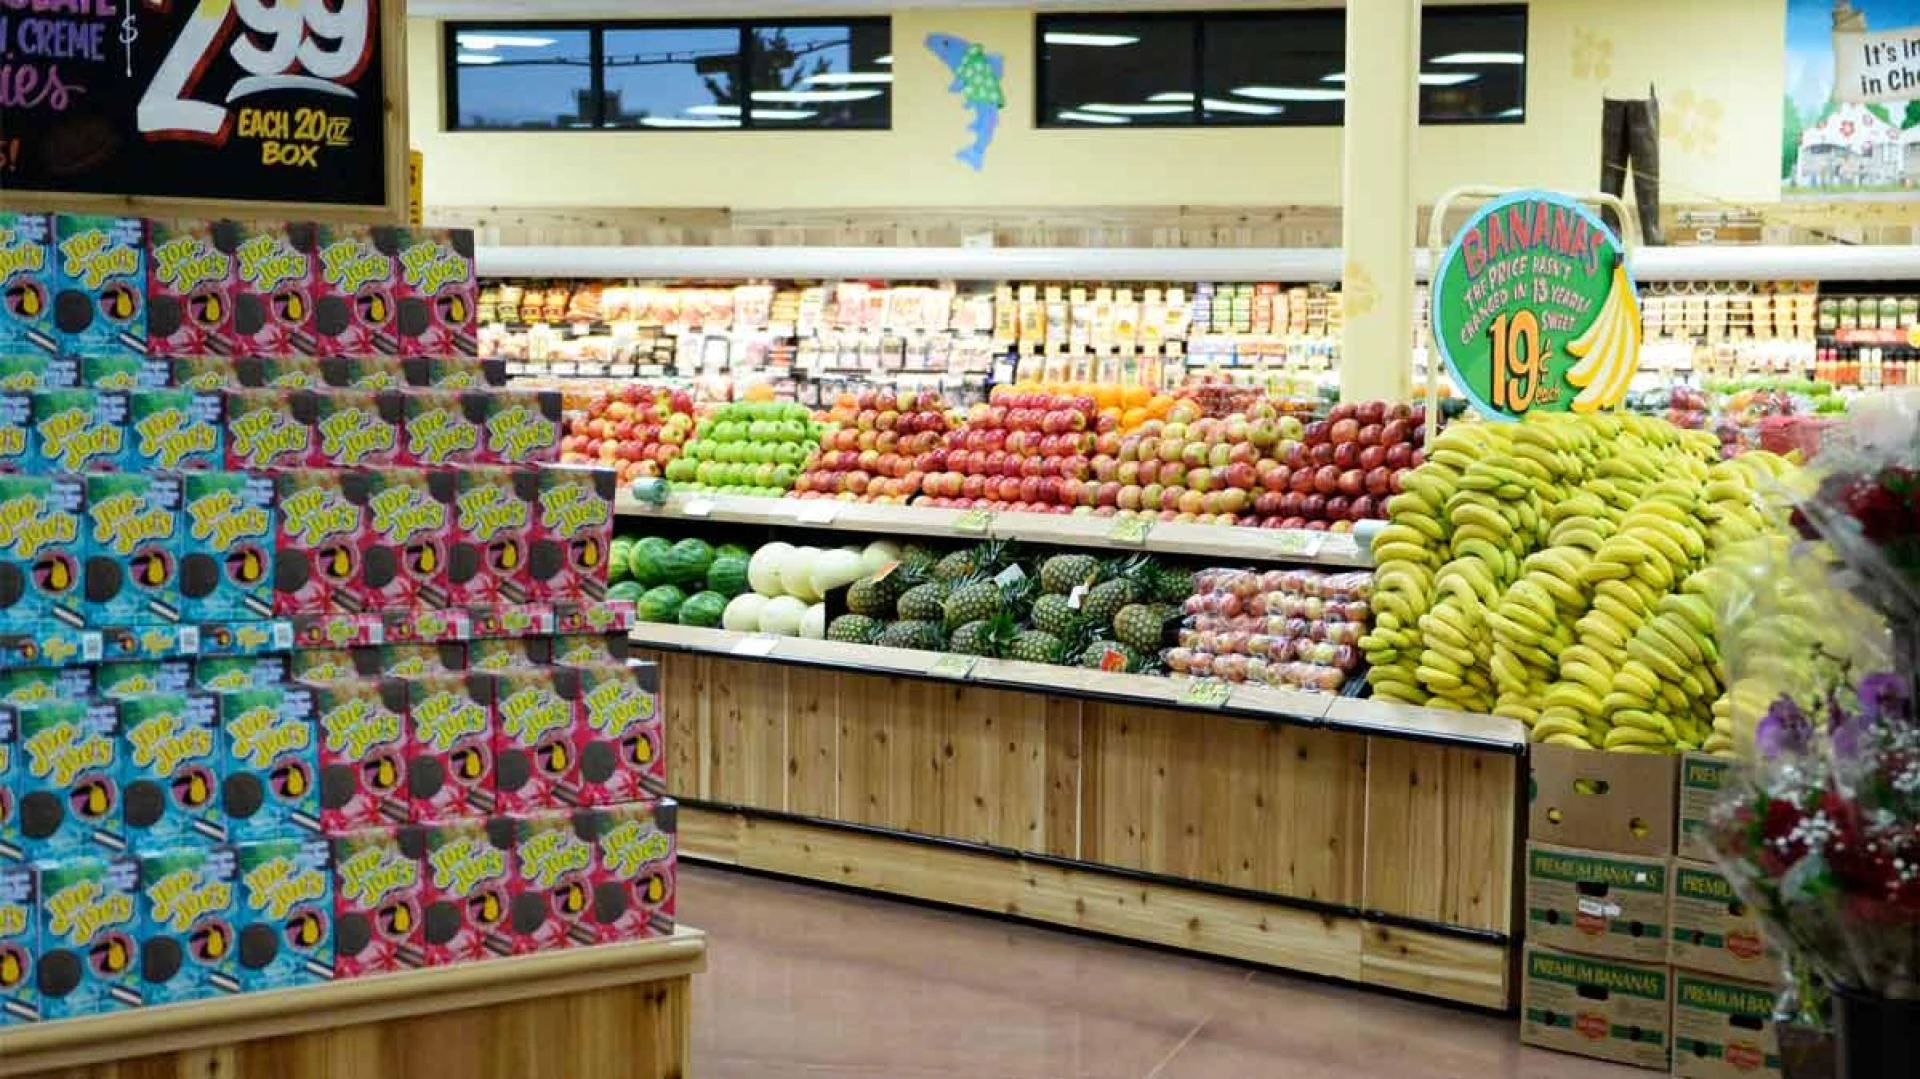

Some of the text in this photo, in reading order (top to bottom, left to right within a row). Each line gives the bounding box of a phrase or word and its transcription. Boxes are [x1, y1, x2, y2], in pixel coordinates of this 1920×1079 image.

[17, 18, 105, 61] CREME
[1864, 41, 1897, 67] It's
[1860, 75, 1882, 97] in
[237, 107, 290, 138] EACH
[294, 107, 327, 141] 20
[261, 140, 319, 168] BOX
[63, 231, 101, 275] Joe
[155, 239, 195, 282] Joe
[238, 234, 272, 280] Joe
[323, 239, 358, 282] Joe
[404, 242, 436, 283] Joe
[1462, 201, 1606, 281] BANANAS
[1464, 279, 1488, 311] THE
[1488, 255, 1528, 291] PRICE
[1514, 282, 1528, 302] IN
[40, 410, 84, 457] Joe
[138, 409, 180, 455] Joe
[233, 408, 272, 455] Joe
[322, 408, 359, 453] Joe
[409, 409, 448, 452] Joe
[488, 407, 525, 448] Joe
[91, 493, 136, 542] Joe
[189, 490, 233, 538] Joe
[282, 486, 322, 534] Joe
[370, 485, 410, 532] Joe
[458, 485, 499, 528] Joe
[541, 483, 580, 525] Joe
[324, 700, 368, 751] Joe
[413, 691, 450, 742] Joe
[501, 690, 539, 736] Joe
[586, 679, 622, 728] Joe
[27, 724, 73, 775] Joe
[129, 714, 173, 765] Joe
[229, 706, 272, 757] Joe
[431, 838, 471, 888] Joe
[519, 831, 556, 880] Joe
[601, 822, 640, 868] Joe
[149, 869, 194, 921] Joe
[246, 857, 290, 909] Joe
[339, 849, 380, 898] Joe
[1592, 862, 1658, 888] BANANS
[48, 881, 94, 934] Joe
[1533, 957, 1658, 993] PREMIUM BANANAS
